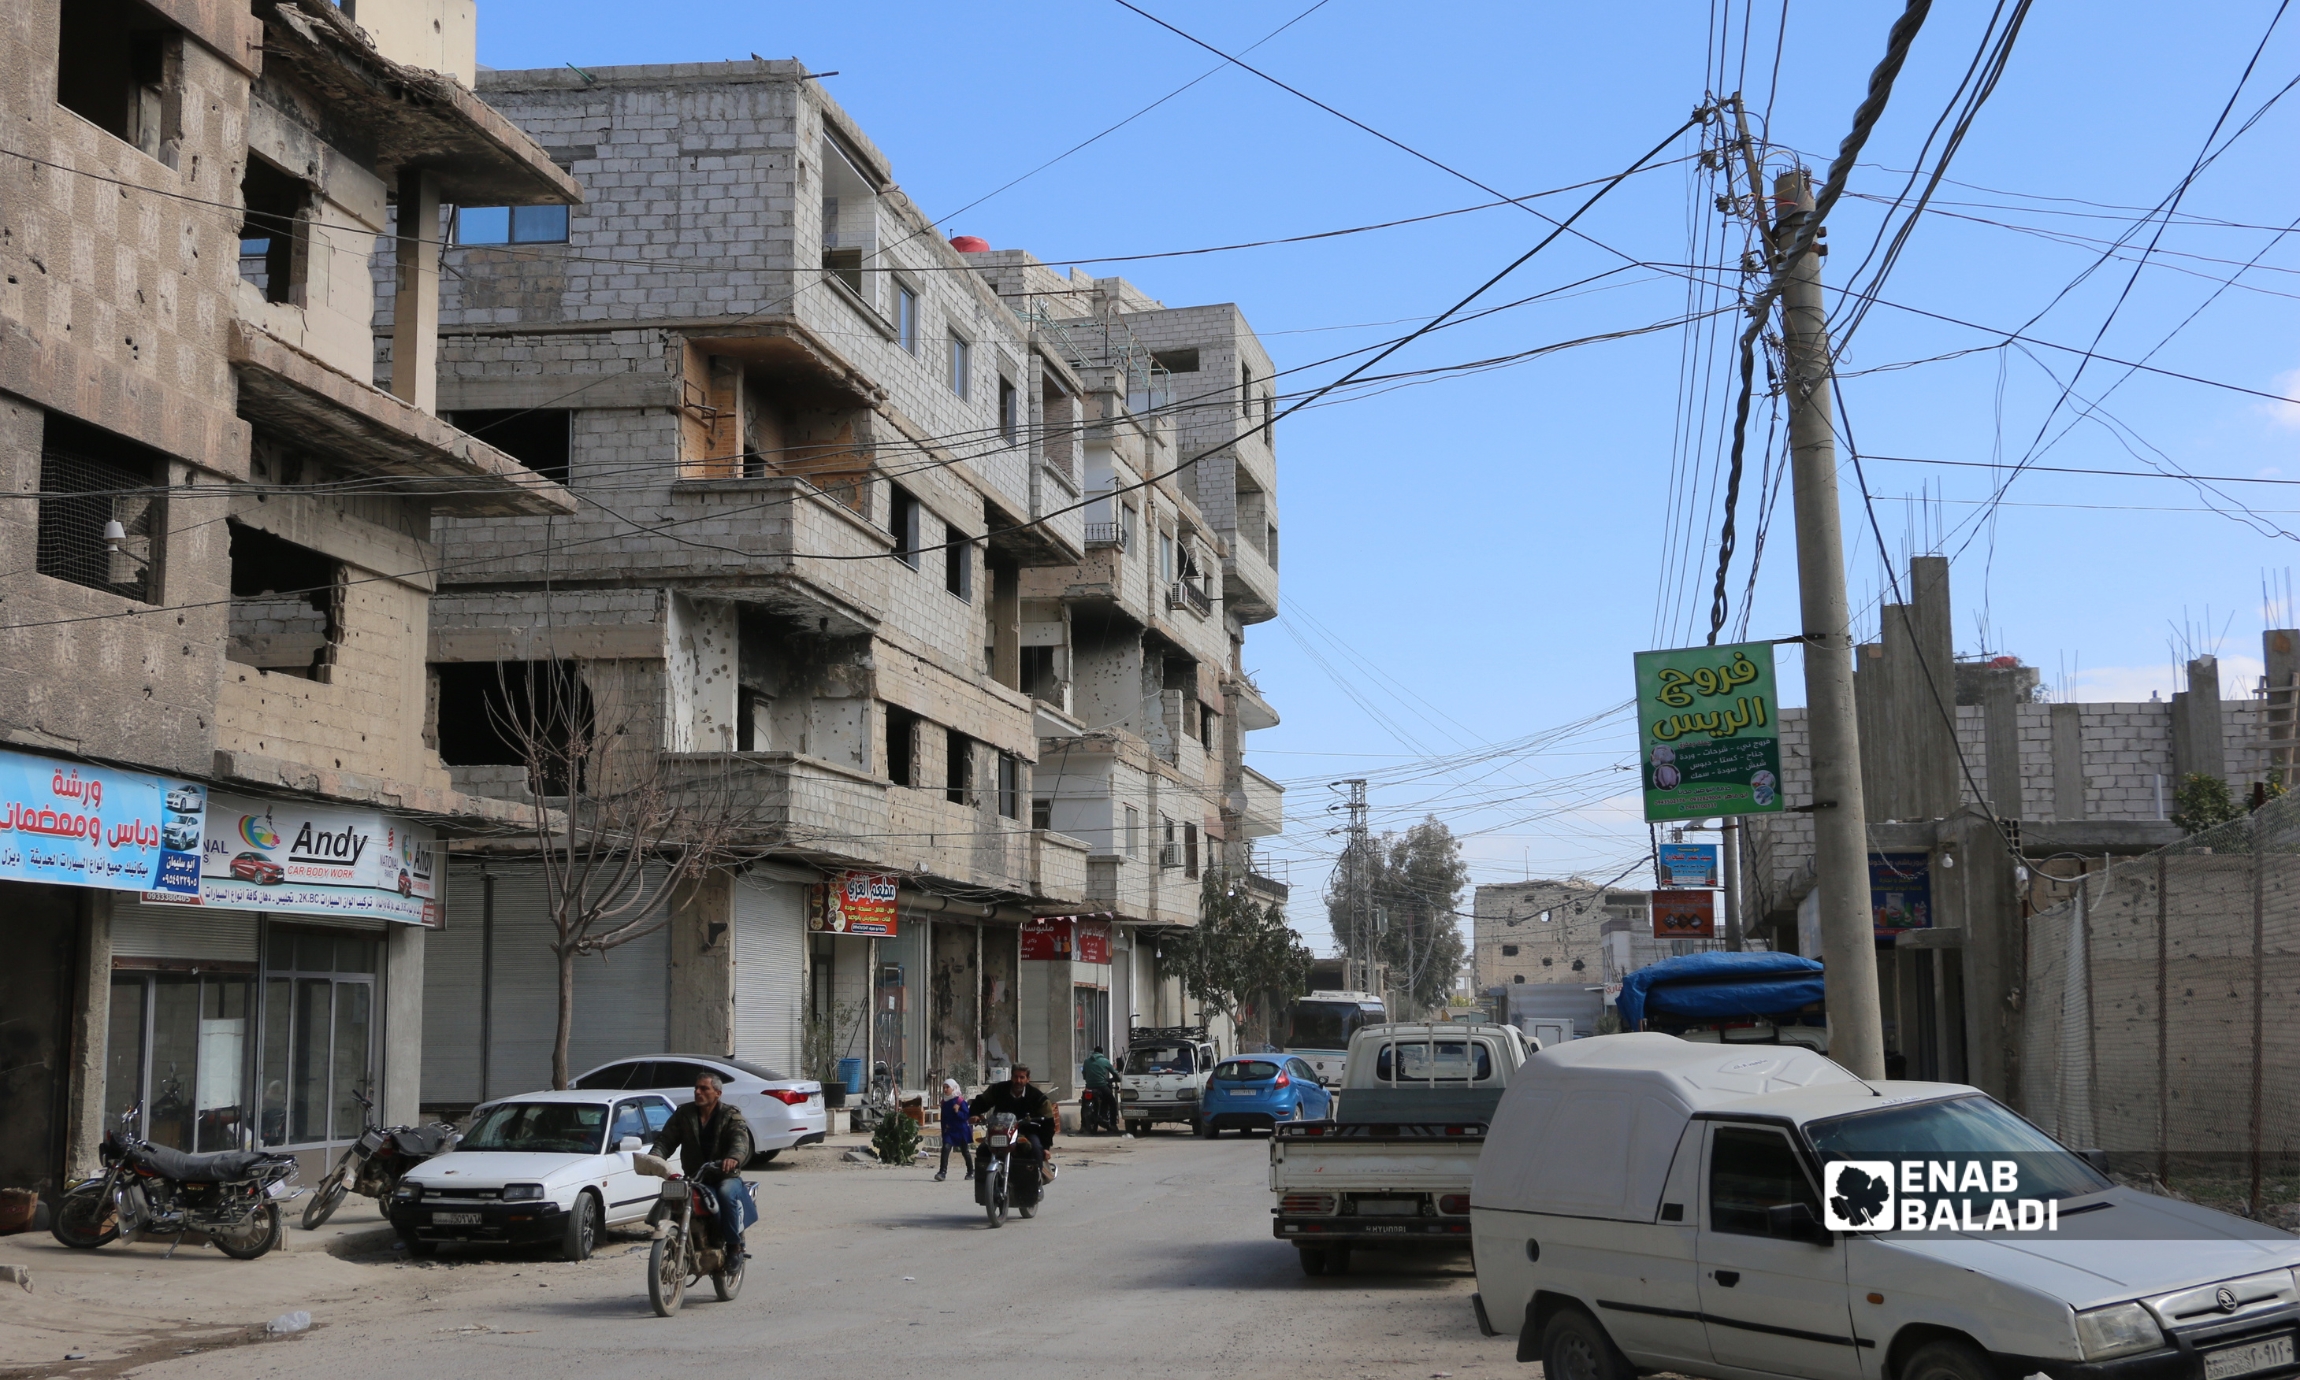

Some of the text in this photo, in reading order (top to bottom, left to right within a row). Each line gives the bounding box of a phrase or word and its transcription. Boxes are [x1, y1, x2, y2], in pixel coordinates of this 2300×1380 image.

[1655, 651, 1758, 708] فروج
[1652, 696, 1767, 740] الريس
[1703, 745, 1728, 756] شرحات
[1753, 739, 1771, 749] فروج
[1679, 753, 1695, 761] وردة
[1746, 751, 1764, 760] جناح
[1690, 760, 1712, 770] دبوس
[1717, 766, 1737, 774] سودة
[1690, 771, 1709, 779] سمك
[52, 769, 102, 807] ورشة
[0, 802, 159, 851] دباس ومعضمان
[290, 822, 368, 866] Andy
[30, 848, 58, 868] الحديثة
[60, 853, 88, 872] السيارات
[166, 855, 186, 870] سليمان
[107, 862, 122, 876] جميع
[125, 862, 148, 878] ميكانيك
[288, 866, 355, 878] CAR BODY WORK
[205, 886, 230, 902] السيارات
[231, 888, 245, 903] أنواع
[246, 888, 258, 901] كافة
[870, 876, 896, 903] مطعم
[299, 893, 319, 904] 2K.BC
[321, 894, 342, 908] السيارات
[343, 895, 356, 908] ألوان
[356, 896, 373, 909] تركيب
[1020, 923, 1054, 935] ملبوسا
[1372, 1225, 1406, 1233] HYUNDAI
